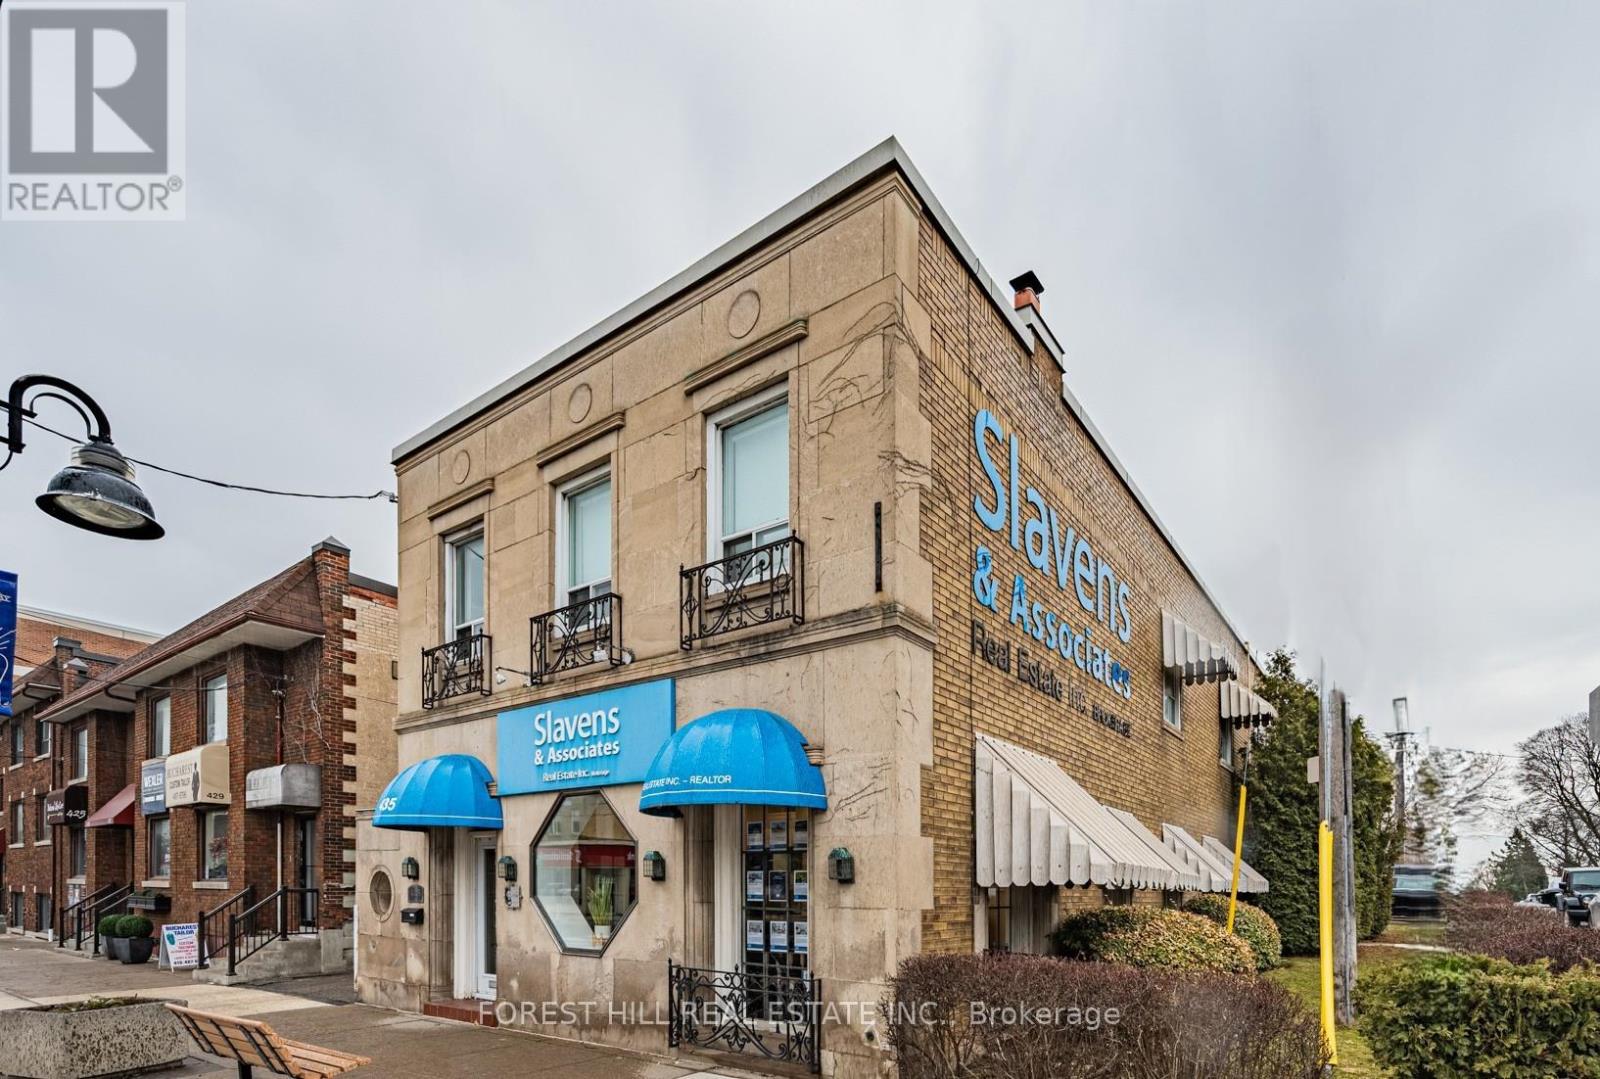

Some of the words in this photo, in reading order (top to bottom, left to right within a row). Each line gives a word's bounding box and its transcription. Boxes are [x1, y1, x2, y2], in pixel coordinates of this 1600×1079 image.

[972, 408, 1132, 644] Slavens
[972, 545, 999, 613] &
[1010, 575, 1132, 701] Associates
[971, 619, 1010, 673] Real
[1018, 647, 1063, 702] Estate
[534, 706, 621, 746] Slavens
[534, 749, 545, 766] &
[547, 740, 621, 764] Associates
[690, 774, 732, 784] REALTOR
[207, 792, 225, 800] 429
[379, 796, 398, 812] 35
[66, 809, 87, 820] 425
